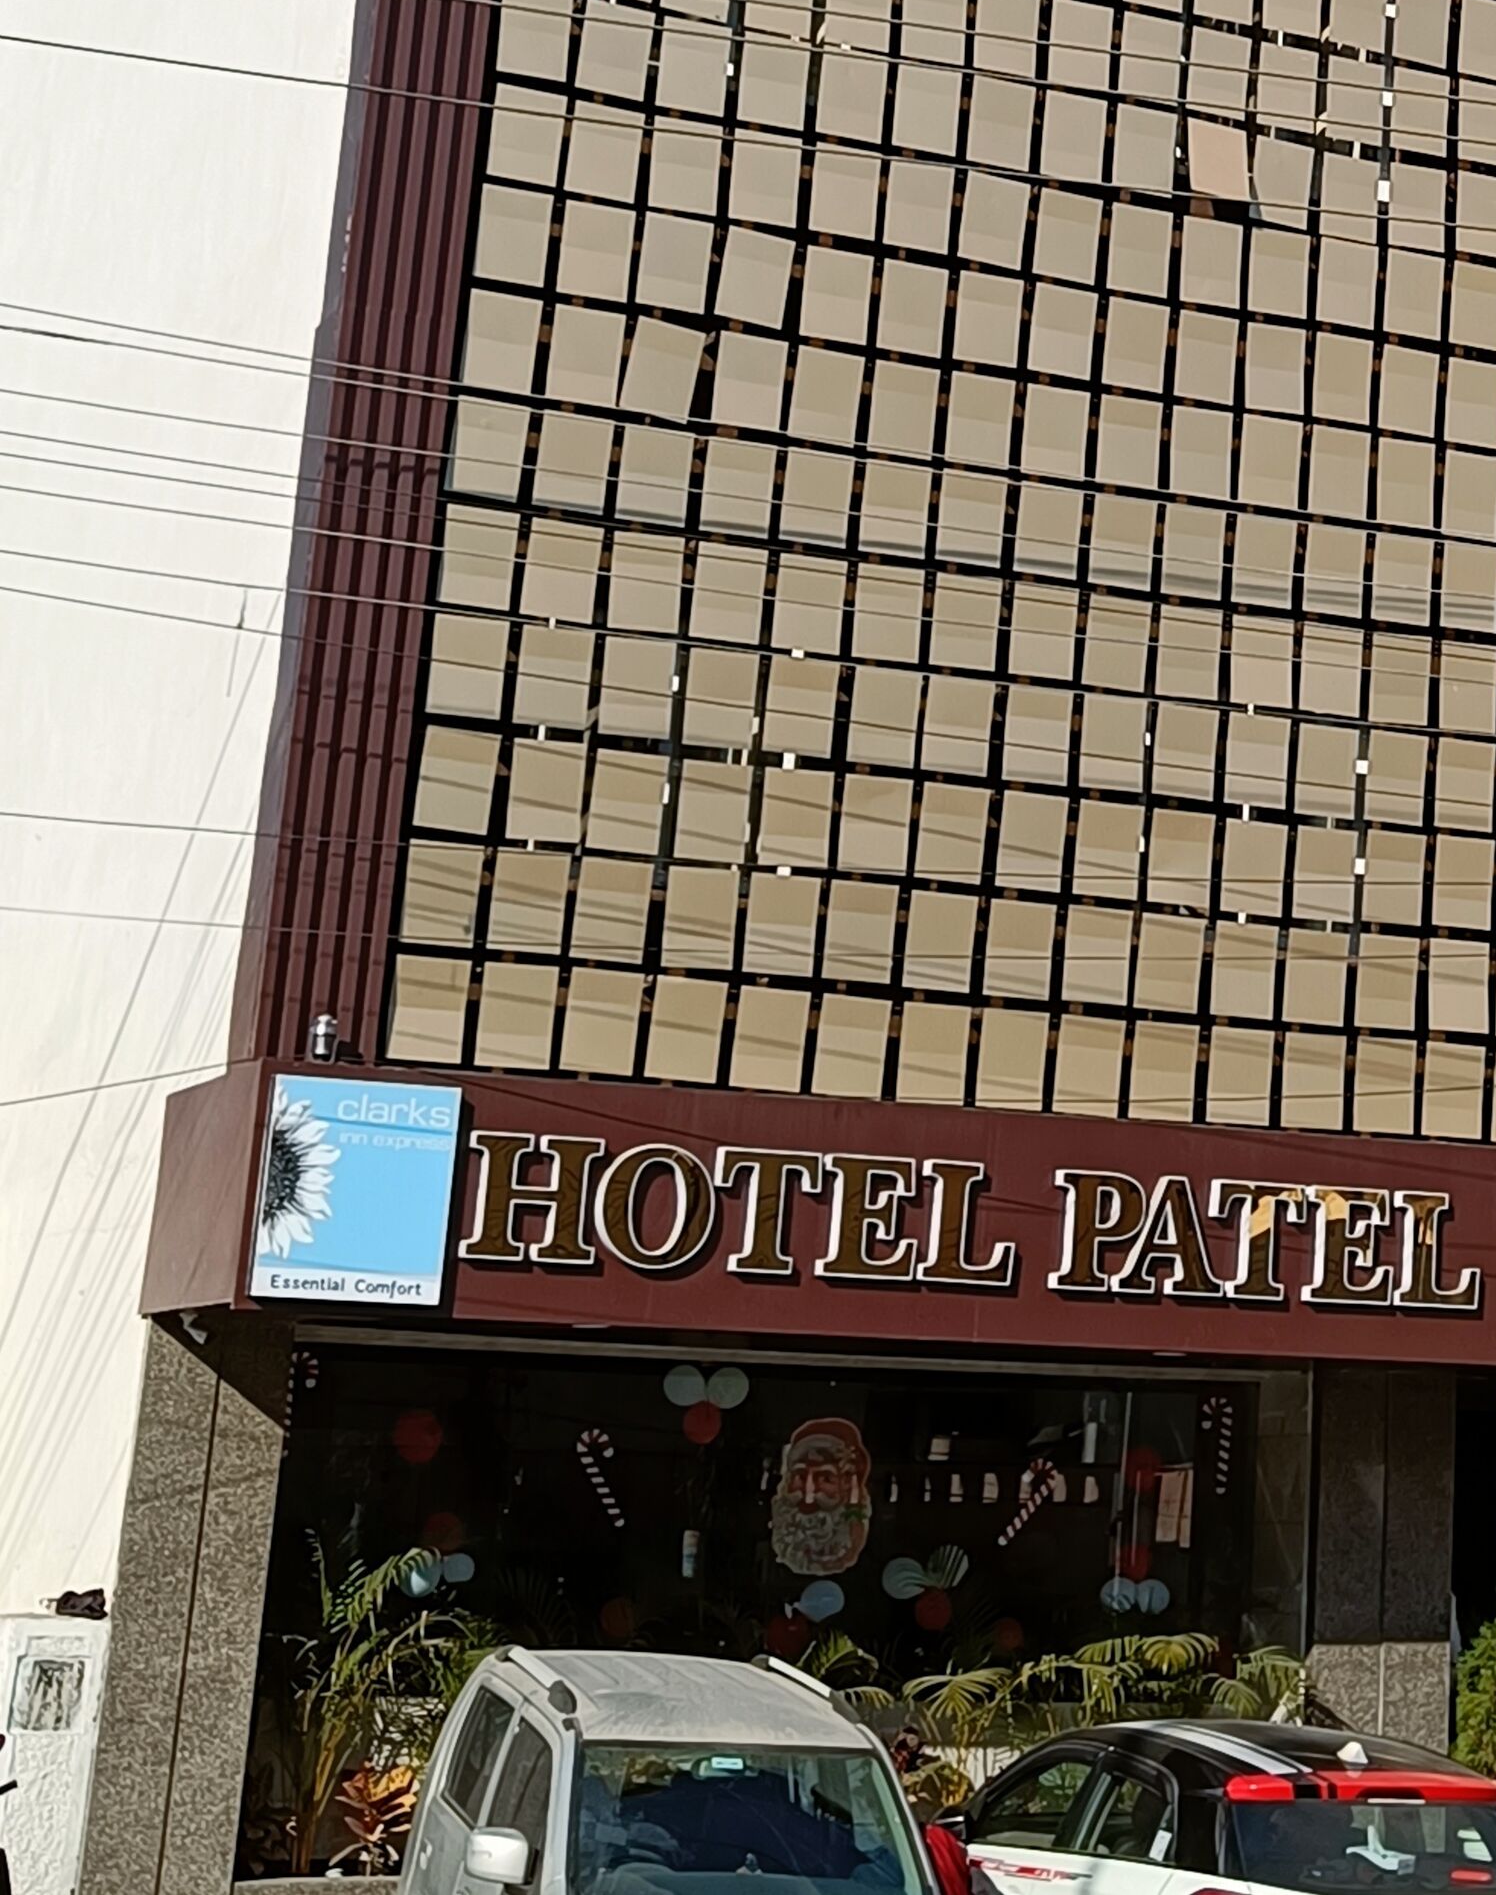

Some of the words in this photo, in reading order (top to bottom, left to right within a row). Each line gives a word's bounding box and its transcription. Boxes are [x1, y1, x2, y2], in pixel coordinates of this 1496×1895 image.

[336, 1093, 451, 1127] clarks
[339, 1131, 368, 1146] inn
[373, 1135, 451, 1151] express
[457, 1129, 1017, 1288] HOTEL
[1046, 1167, 1481, 1312] PATEL
[270, 1274, 346, 1292] Essential
[354, 1278, 422, 1299] Comfort
